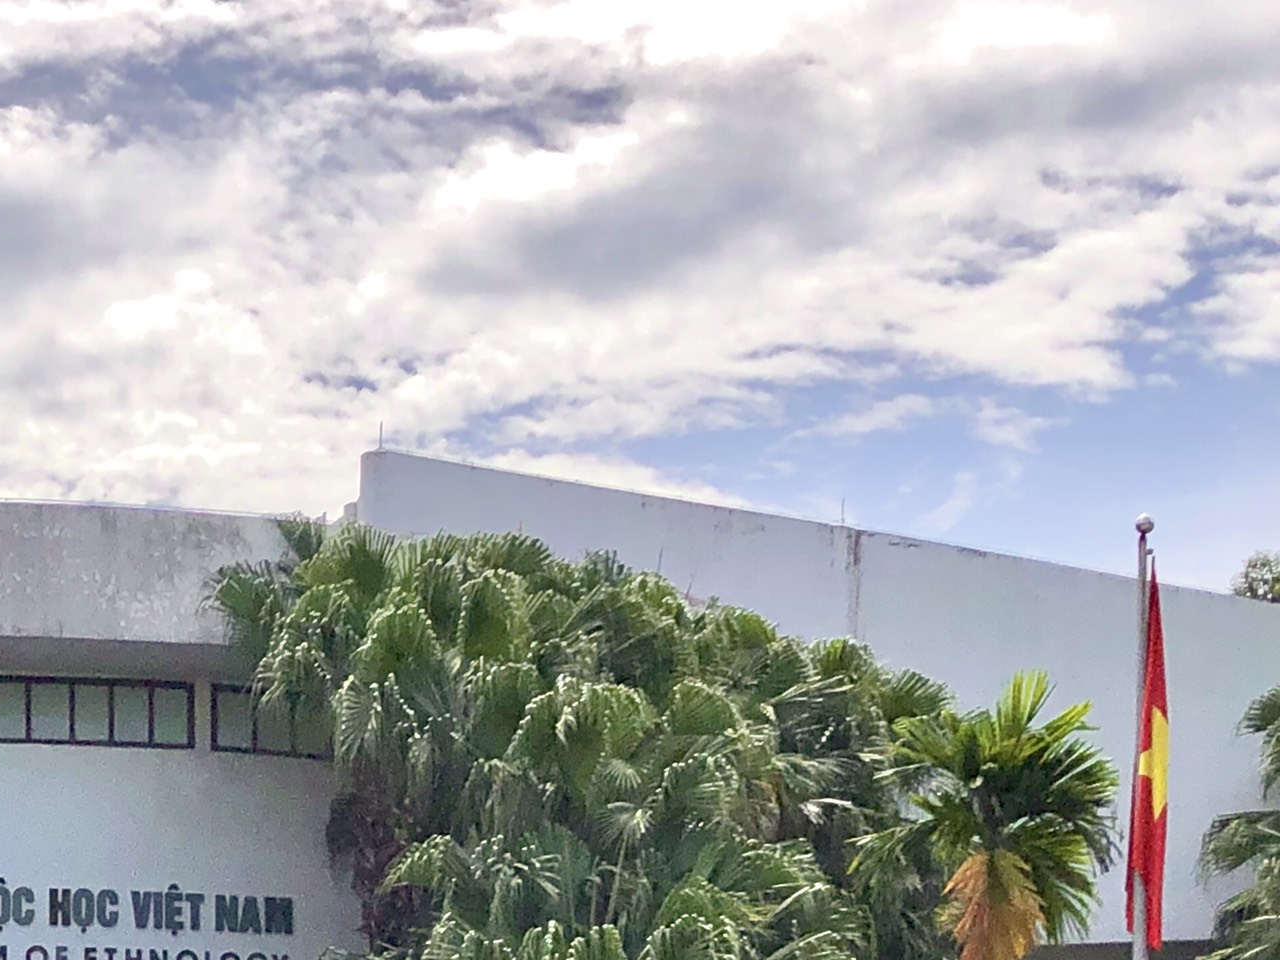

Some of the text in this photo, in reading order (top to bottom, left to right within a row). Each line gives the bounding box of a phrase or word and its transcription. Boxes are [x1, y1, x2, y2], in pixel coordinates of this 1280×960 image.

[48, 887, 119, 933] HỌC
[131, 883, 205, 935] VIỆT
[215, 894, 294, 934] NAM
